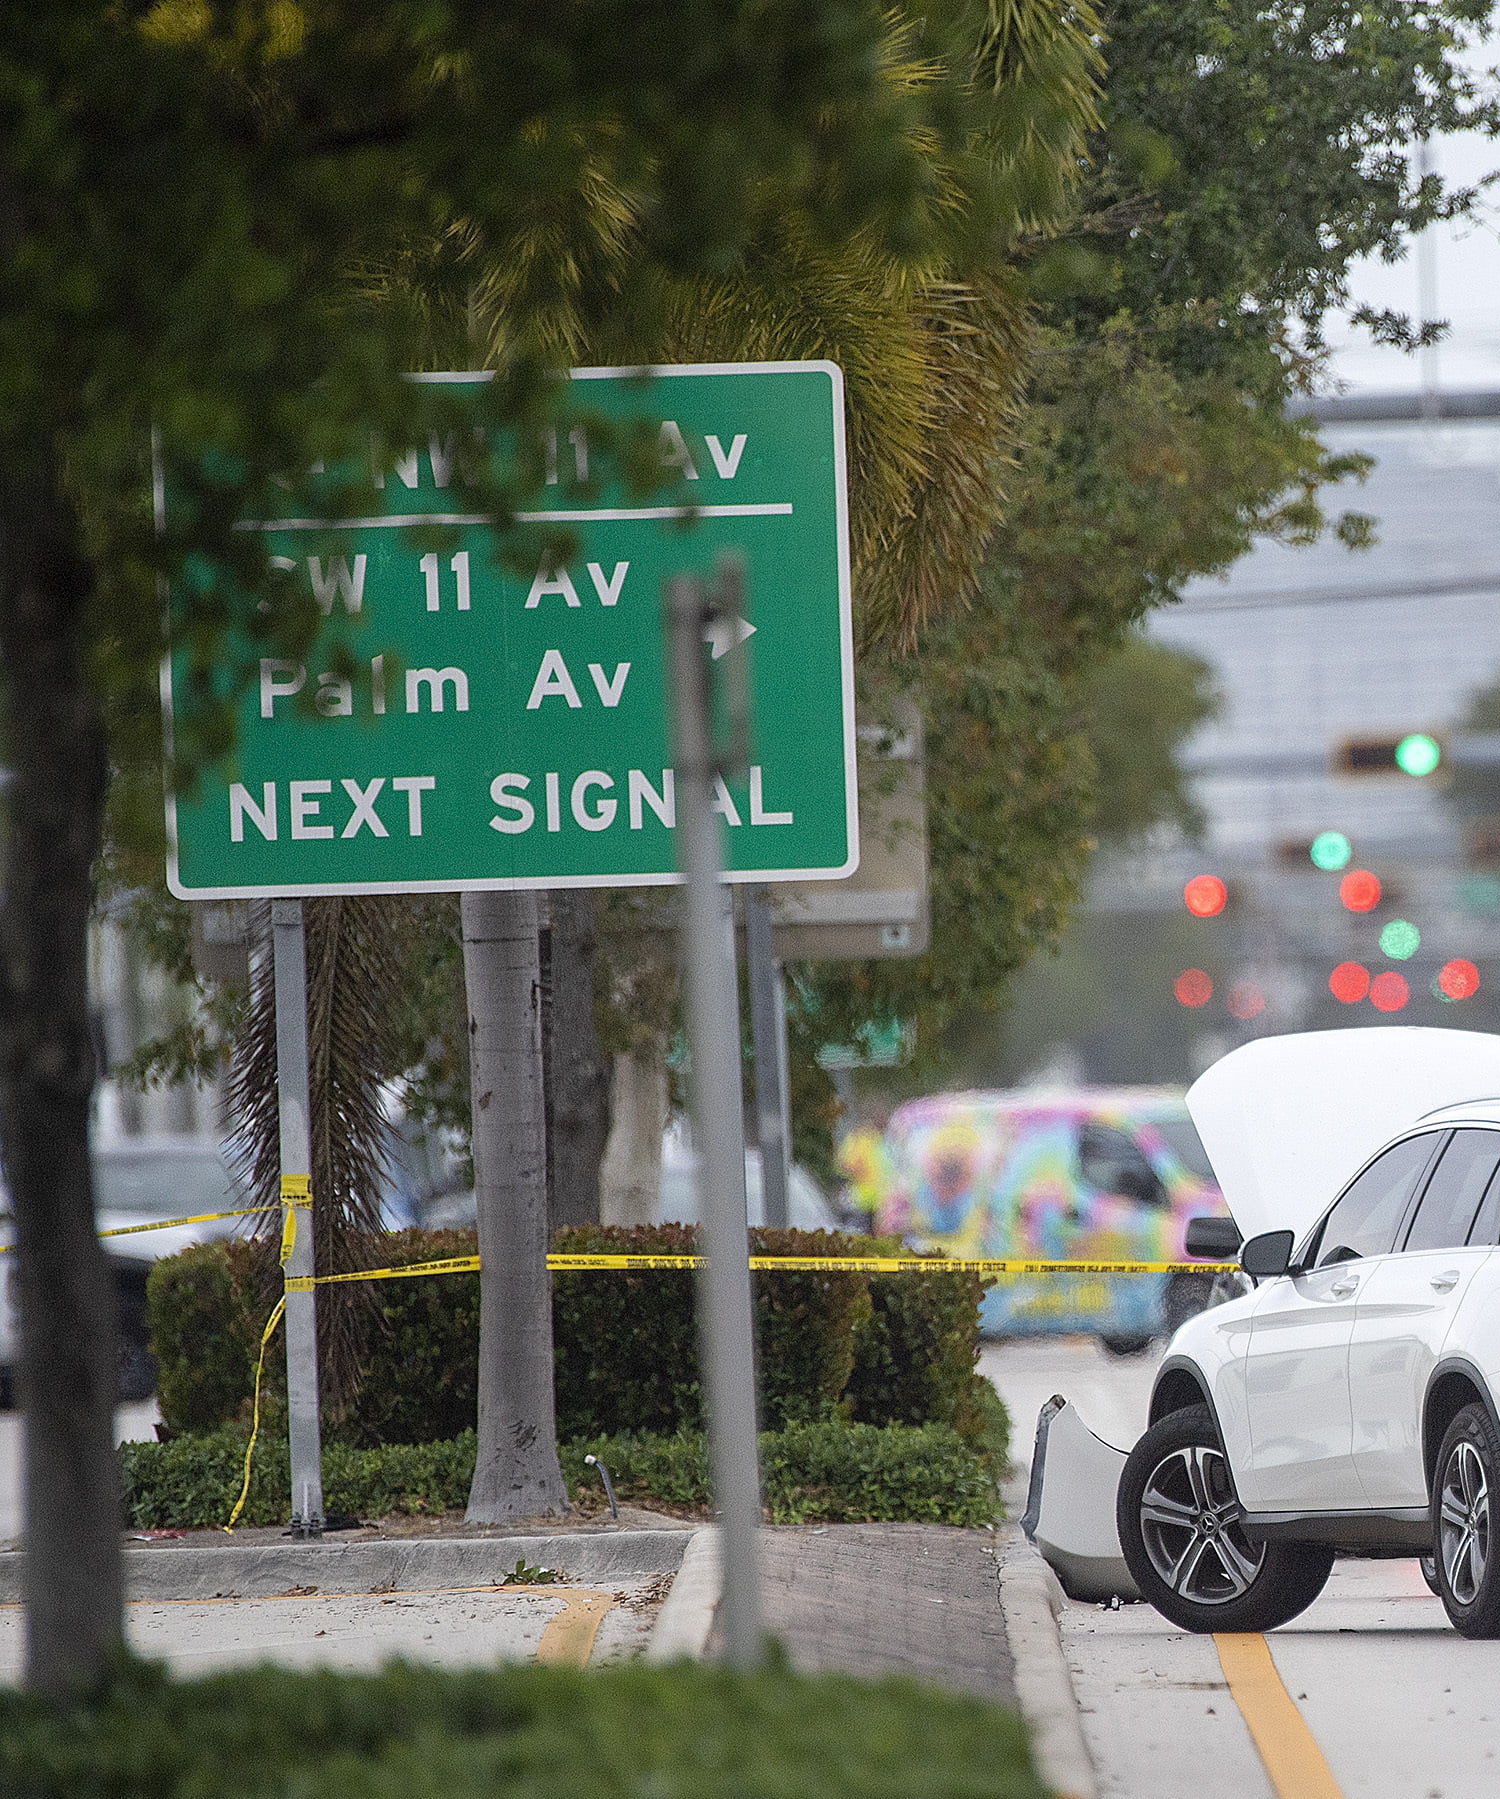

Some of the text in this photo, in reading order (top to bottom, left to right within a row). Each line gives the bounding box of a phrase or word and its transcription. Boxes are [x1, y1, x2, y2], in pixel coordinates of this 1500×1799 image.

[658, 420, 747, 481] Av
[419, 551, 470, 612] 11
[524, 548, 630, 610] Av
[260, 649, 631, 718] Palm Av
[231, 775, 436, 842] NEXT
